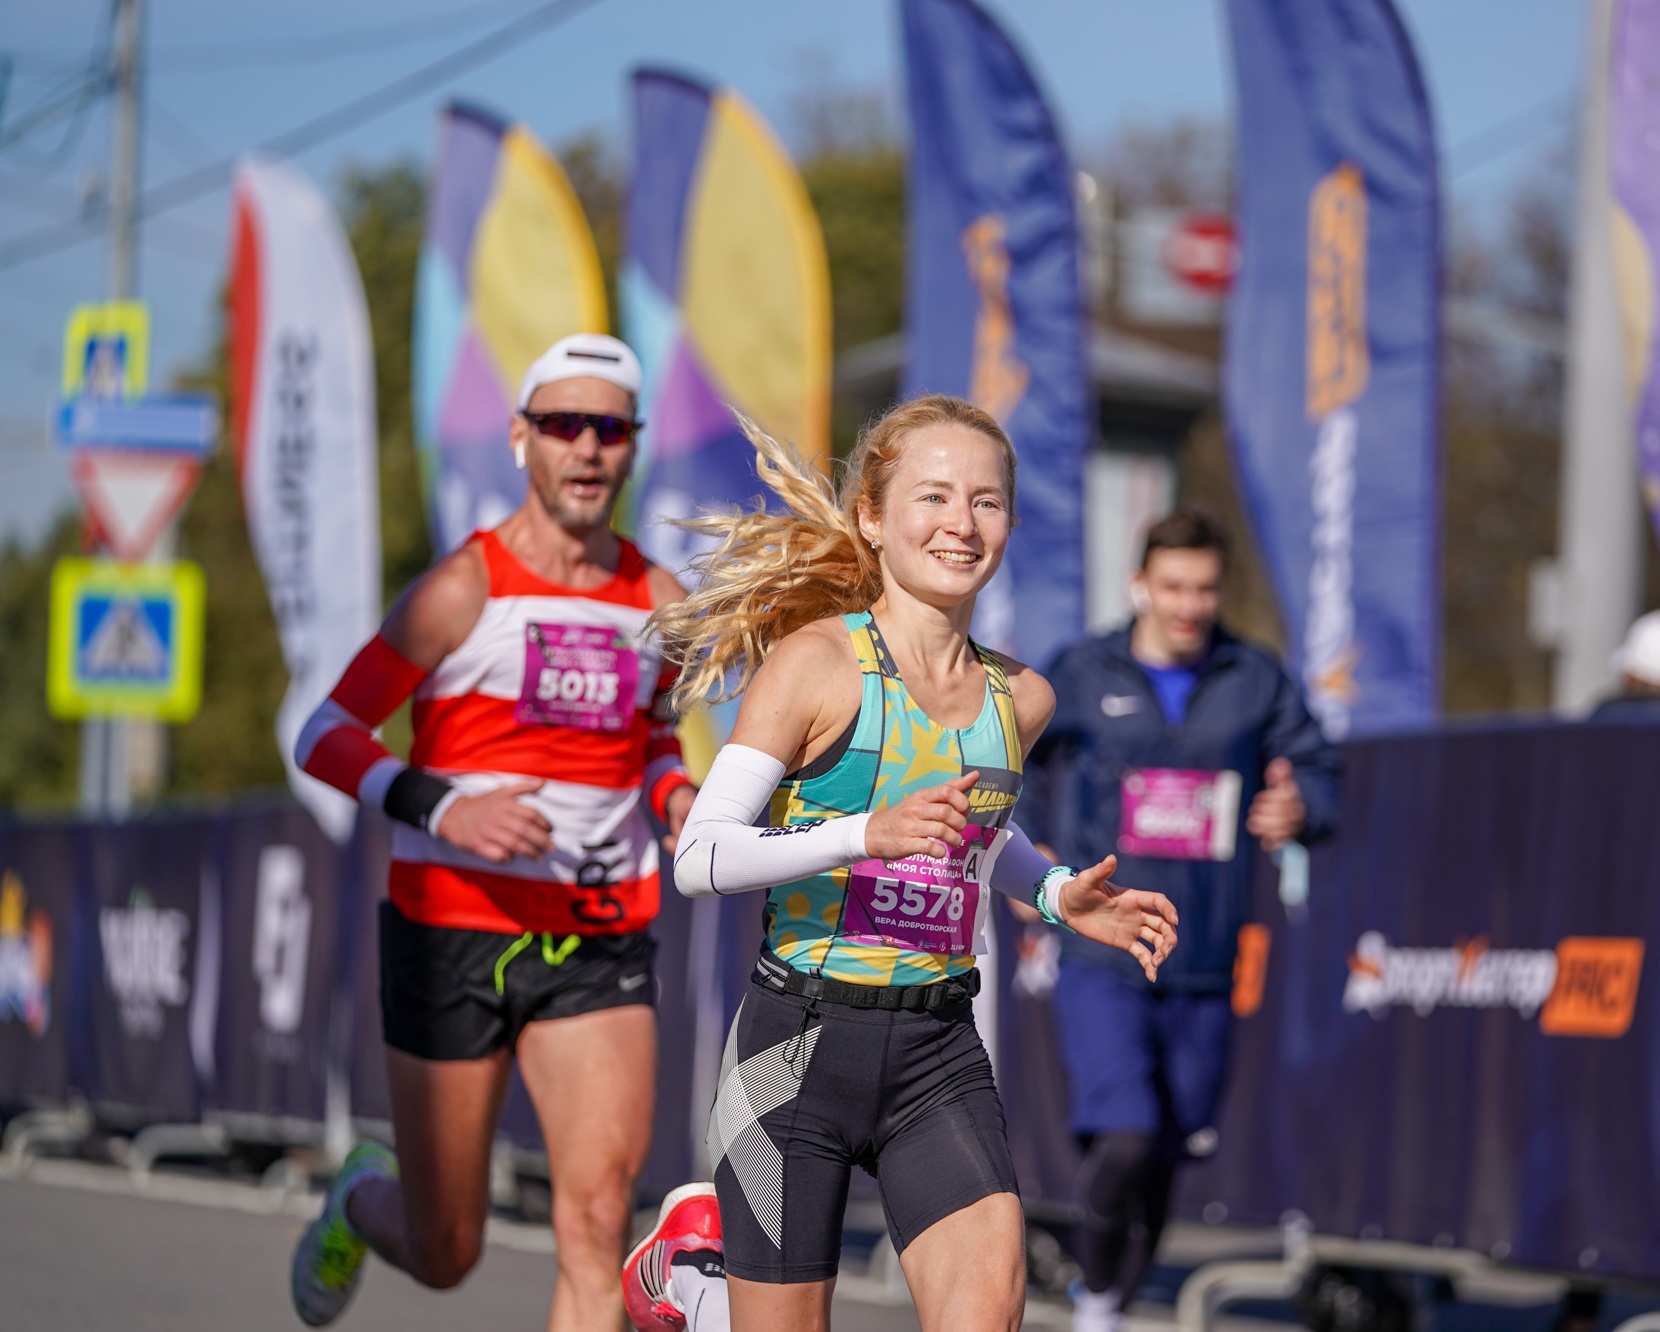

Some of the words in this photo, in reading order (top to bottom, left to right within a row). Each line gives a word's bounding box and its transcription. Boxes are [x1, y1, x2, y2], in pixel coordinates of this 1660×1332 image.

[536, 667, 620, 705] 5013
[905, 853, 965, 867] ОЛУМАРАФОН
[886, 862, 917, 874] «МОЯ
[920, 866, 962, 879] СТОЛИЦА»
[870, 876, 965, 921] 5578
[875, 916, 897, 926] ВЕРА
[897, 919, 958, 933] ДОБРОТВОРСКАЯ
